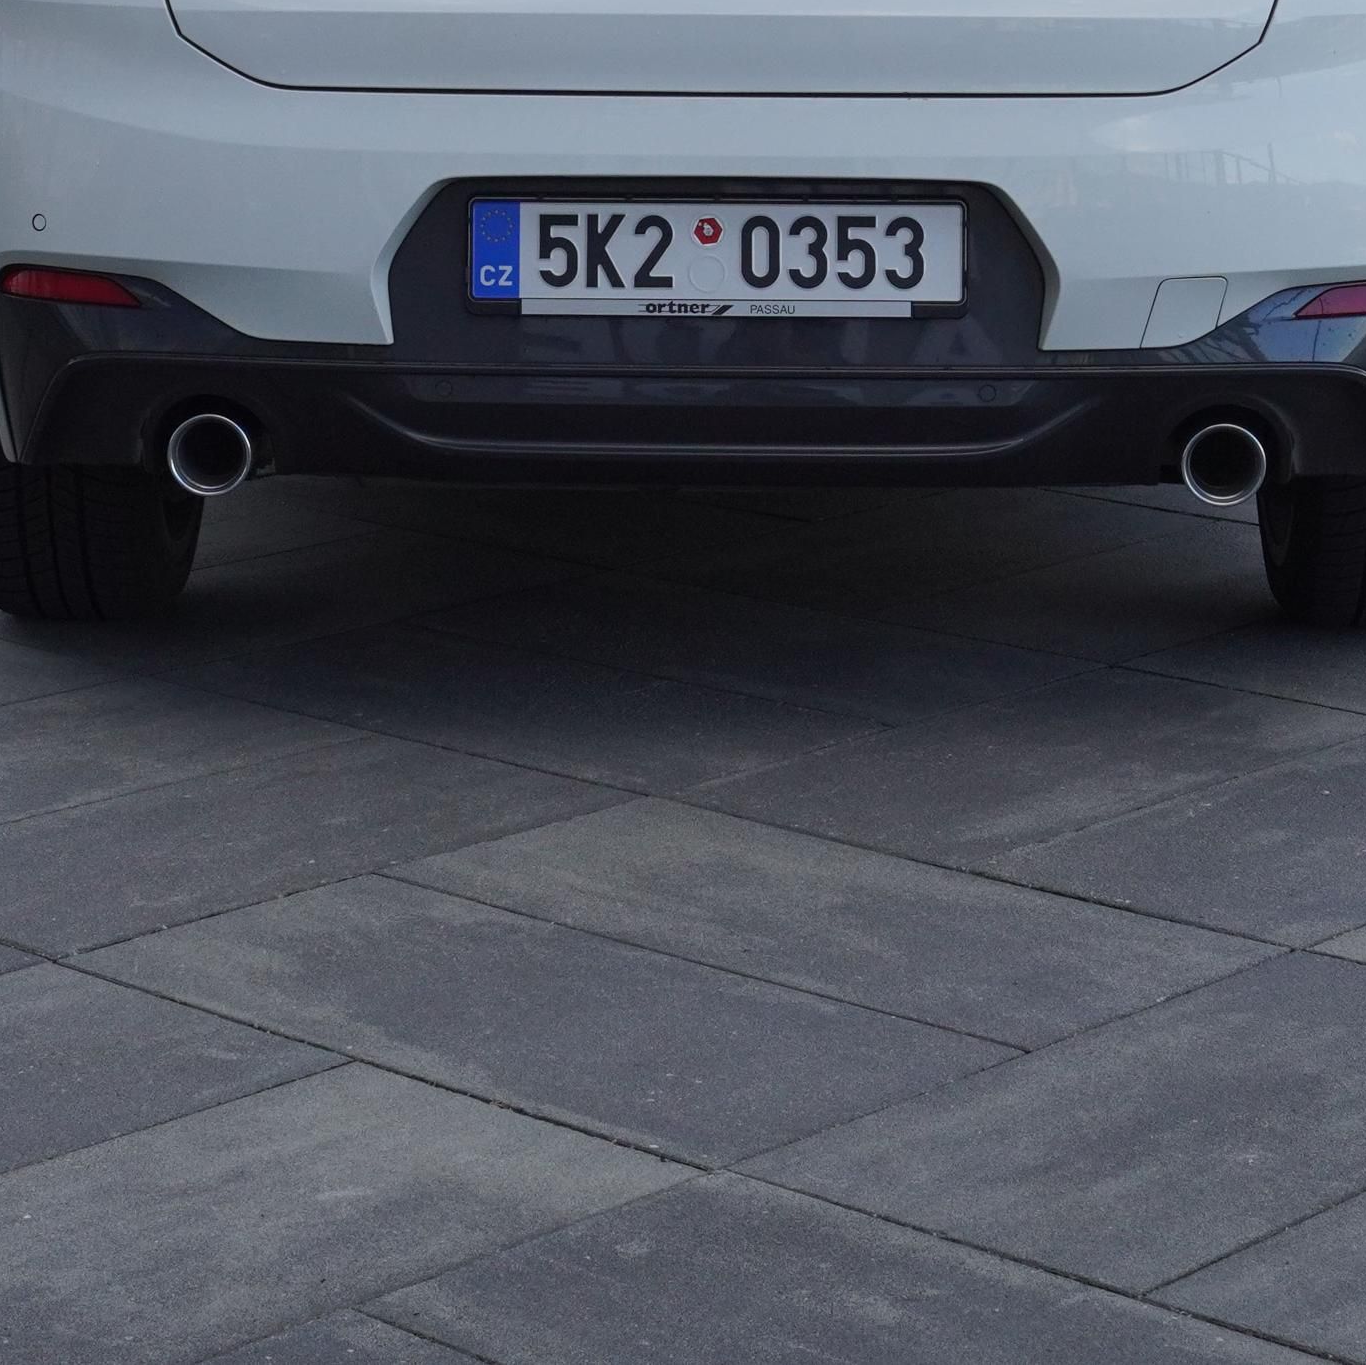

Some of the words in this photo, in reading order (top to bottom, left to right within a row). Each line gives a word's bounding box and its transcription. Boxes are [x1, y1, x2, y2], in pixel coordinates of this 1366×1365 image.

[538, 213, 675, 289] 5K2
[740, 215, 925, 290] 0353
[479, 264, 514, 287] CZ
[645, 300, 711, 314] ortner
[750, 305, 795, 315] PASSAU
